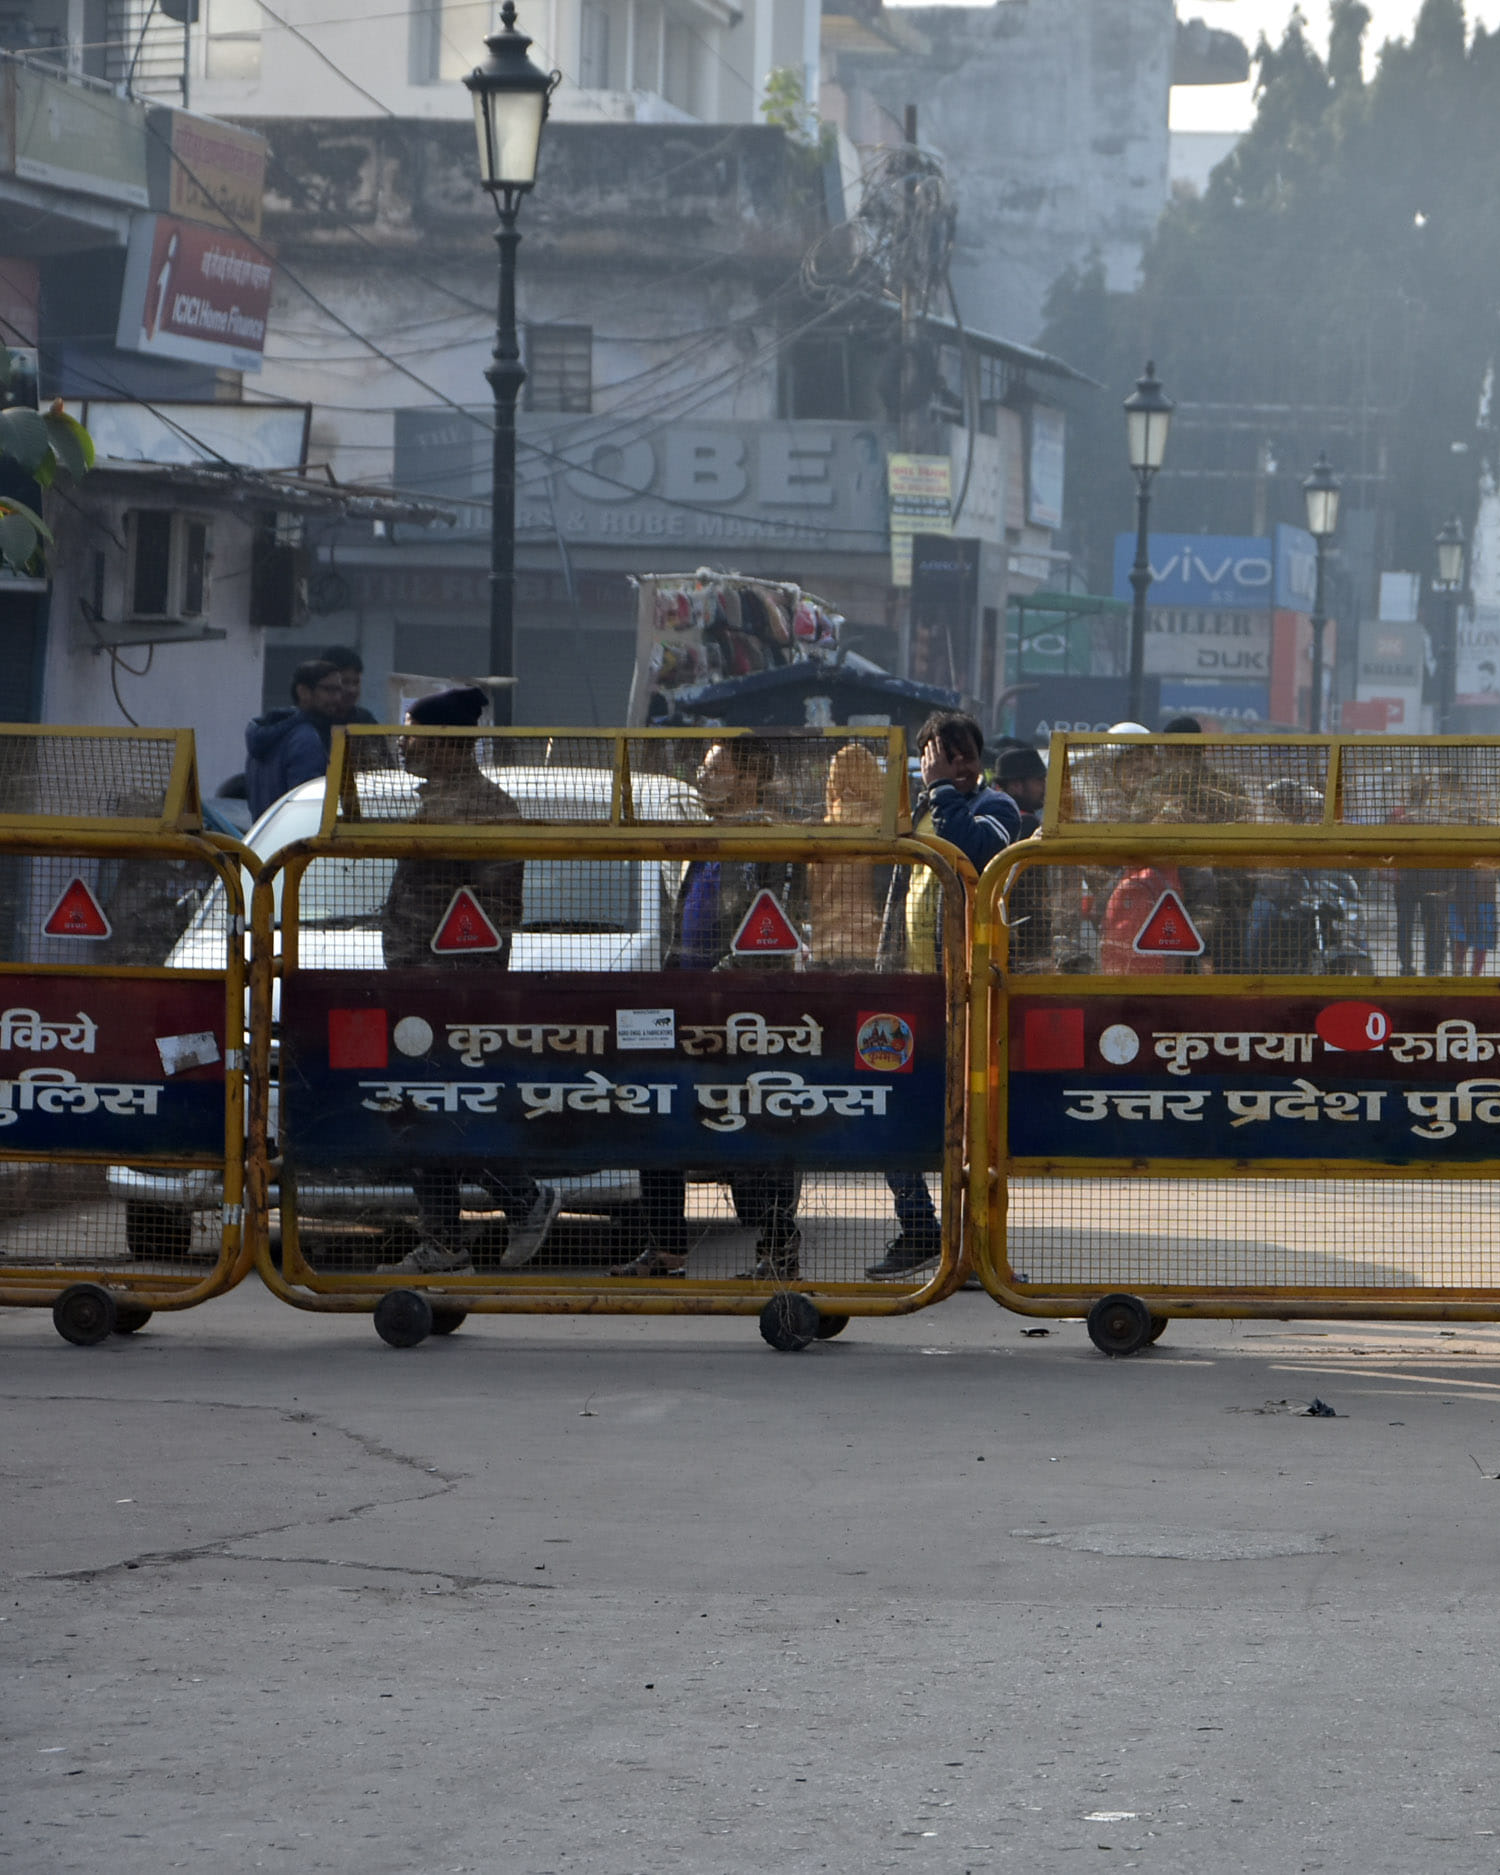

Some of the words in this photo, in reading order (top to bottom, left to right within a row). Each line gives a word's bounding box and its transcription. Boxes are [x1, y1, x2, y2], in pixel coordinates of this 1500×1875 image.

[470, 427, 833, 505] ROBE
[601, 513, 685, 535] ROBE
[1147, 546, 1272, 586] vivo
[1146, 611, 1253, 637] KILLER
[1198, 649, 1272, 670] DUK
[445, 1024, 609, 1068] कृपया
[680, 1012, 824, 1056] रुकिये
[1152, 1032, 1318, 1076] कृपया
[358, 1081, 505, 1113] उत्तर
[517, 1070, 678, 1120] प्रदेश
[694, 1070, 893, 1133] पुलिस
[1063, 1090, 1212, 1122] उत्तर
[1223, 1078, 1388, 1128] प्रदेश
